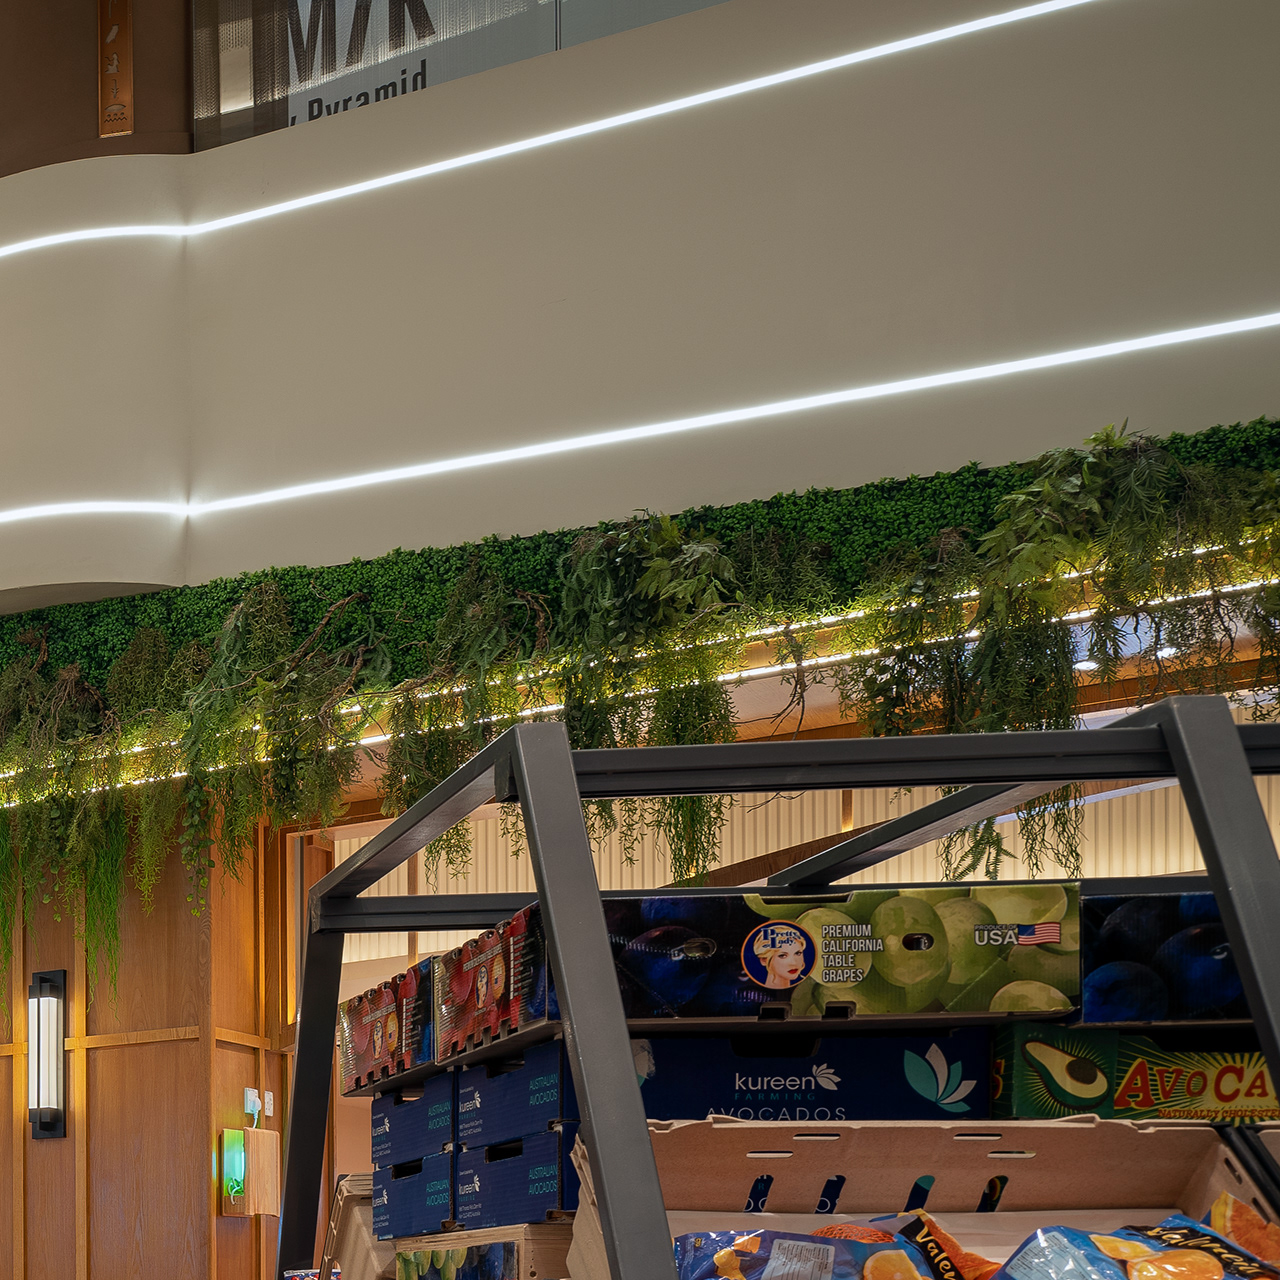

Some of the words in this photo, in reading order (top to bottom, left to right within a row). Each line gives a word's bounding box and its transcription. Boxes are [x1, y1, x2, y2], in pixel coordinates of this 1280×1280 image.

[761, 928, 800, 941] Pretty
[822, 924, 872, 938] PREMIUM
[974, 930, 1018, 946] USA
[822, 939, 884, 953] CALIFORNIA
[822, 954, 855, 967] TABLE
[822, 969, 864, 982] GRAPES
[529, 1073, 558, 1091] AUSTRALIAN
[735, 1072, 815, 1090] kureen
[1114, 1058, 1269, 1108] AVOCA
[529, 1089, 558, 1106] AVOCADOS
[734, 1092, 816, 1100] FARMING
[428, 1101, 451, 1117] AUSTRALIAN
[1158, 1109, 1220, 1118] NATURALLY
[428, 1115, 450, 1131] AVOCADOS
[529, 1165, 558, 1180] AUSTRALIAN
[426, 1179, 450, 1194] AUSTRALIAN
[528, 1180, 557, 1196] AVOCADOS
[426, 1192, 449, 1207] AVOCADOS
